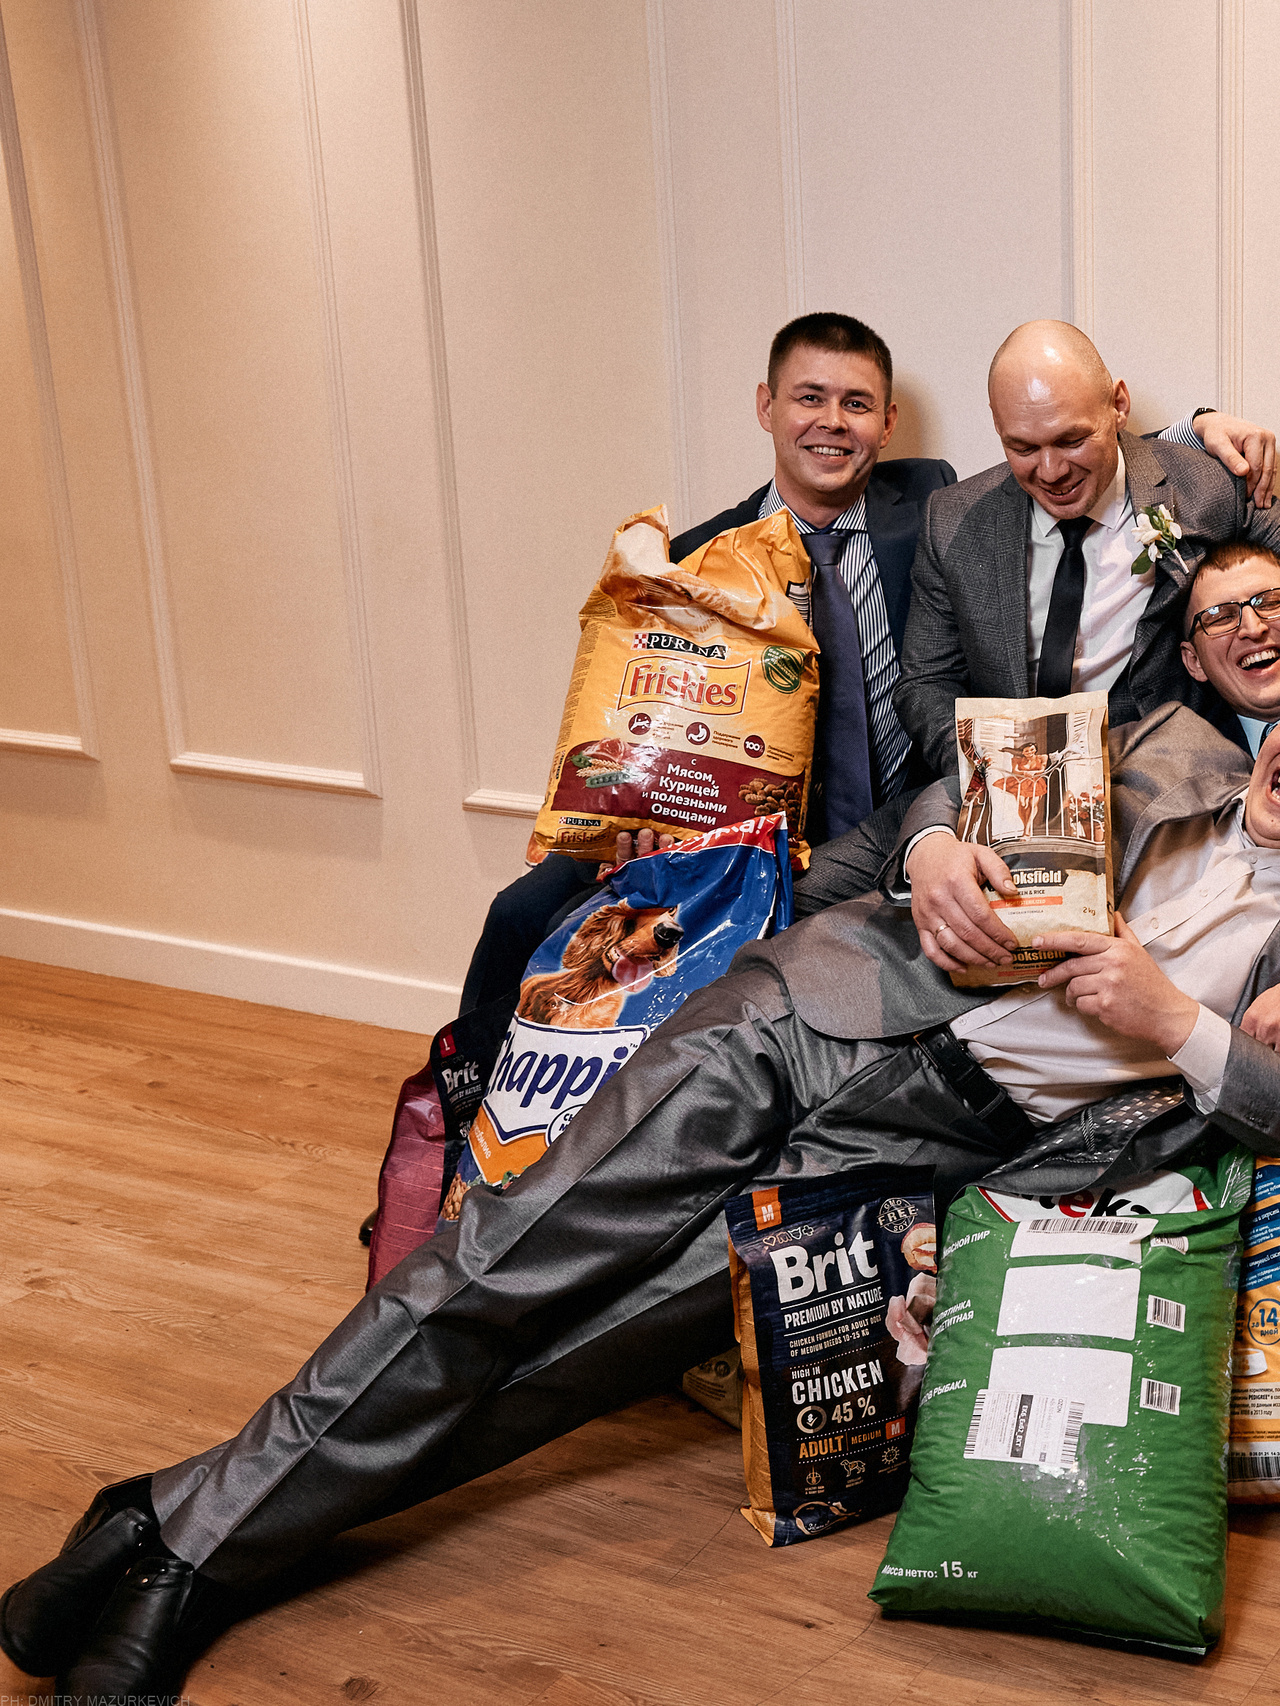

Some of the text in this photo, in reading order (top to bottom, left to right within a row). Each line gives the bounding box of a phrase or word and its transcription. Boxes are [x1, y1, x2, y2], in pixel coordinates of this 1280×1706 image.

[650, 635, 723, 657] PURINA
[630, 664, 737, 706] Friskies
[667, 763, 716, 786] Мясом,
[659, 776, 720, 798] Курицей
[650, 790, 728, 814] полезными
[567, 817, 601, 826] PURINA
[651, 803, 717, 826] Овощами
[561, 831, 607, 844] Friskies
[1013, 870, 1062, 885] oksfield
[441, 1061, 479, 1094] Brit
[761, 1204, 775, 1222] M
[883, 1199, 902, 1210] GMO
[878, 1206, 917, 1227] FREE
[893, 1220, 909, 1232] SOY
[971, 1230, 991, 1244] ПИР
[769, 1231, 879, 1304] Brit
[784, 1286, 884, 1329] PREMIUM BY NATURE
[1259, 1307, 1279, 1327] 14
[789, 1334, 815, 1349] CHICKEN
[815, 1328, 838, 1342] FORMULA
[838, 1325, 850, 1334] FOR
[851, 1318, 870, 1330] ADULT
[790, 1328, 870, 1358] OF MEDIUM BREEDS 10-25 KG
[1260, 1328, 1279, 1336] дней
[791, 1365, 821, 1380] HIGH IN
[791, 1359, 884, 1405] CHICKEN
[933, 1379, 967, 1397] РЫБАКА
[831, 1394, 876, 1424] 45 %
[799, 1421, 901, 1459] ADULT MEDIUM M
[881, 1561, 979, 1579] Масса нетто: 15 кг
